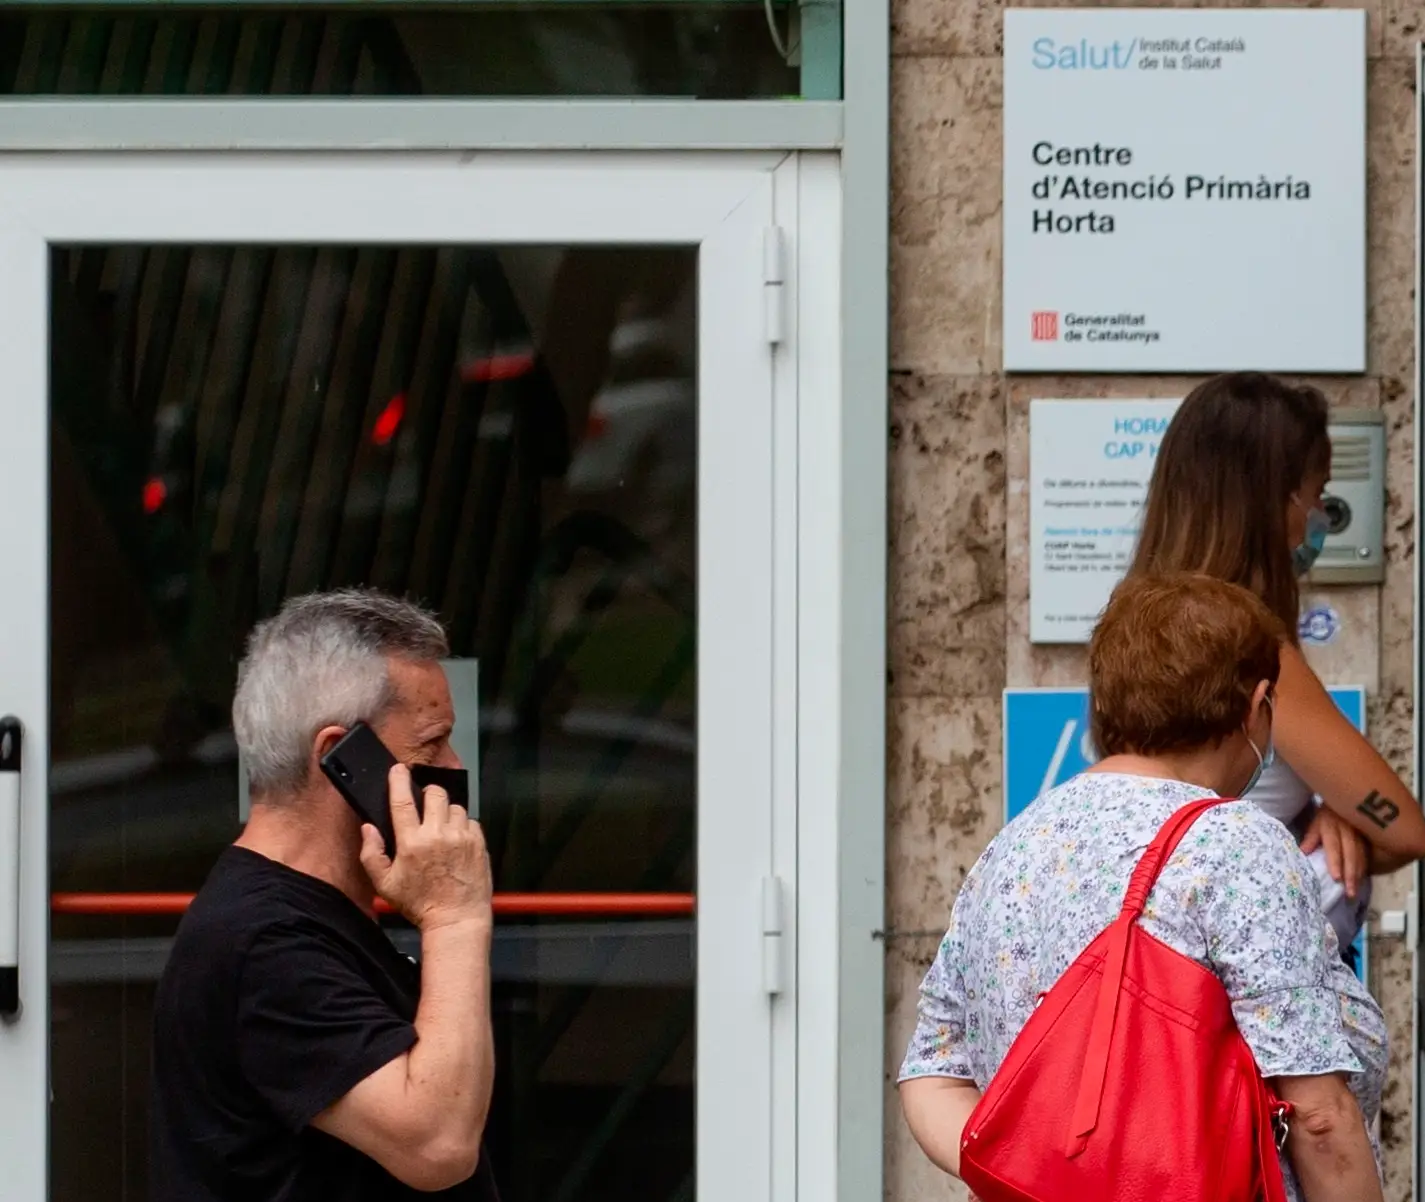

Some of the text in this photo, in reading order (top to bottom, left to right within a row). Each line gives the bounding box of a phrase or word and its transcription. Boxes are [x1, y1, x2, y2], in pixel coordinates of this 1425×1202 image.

[1139, 36, 1246, 53] Institut Català
[1139, 55, 1222, 70] de la Salut
[1032, 141, 1132, 166] Centre
[1032, 175, 1311, 200] d’Atenció Primària
[1032, 209, 1115, 234] Horta
[1064, 313, 1145, 326] Generalitat
[1064, 328, 1160, 343] de Catalunya
[1104, 441, 1144, 459] CAP
